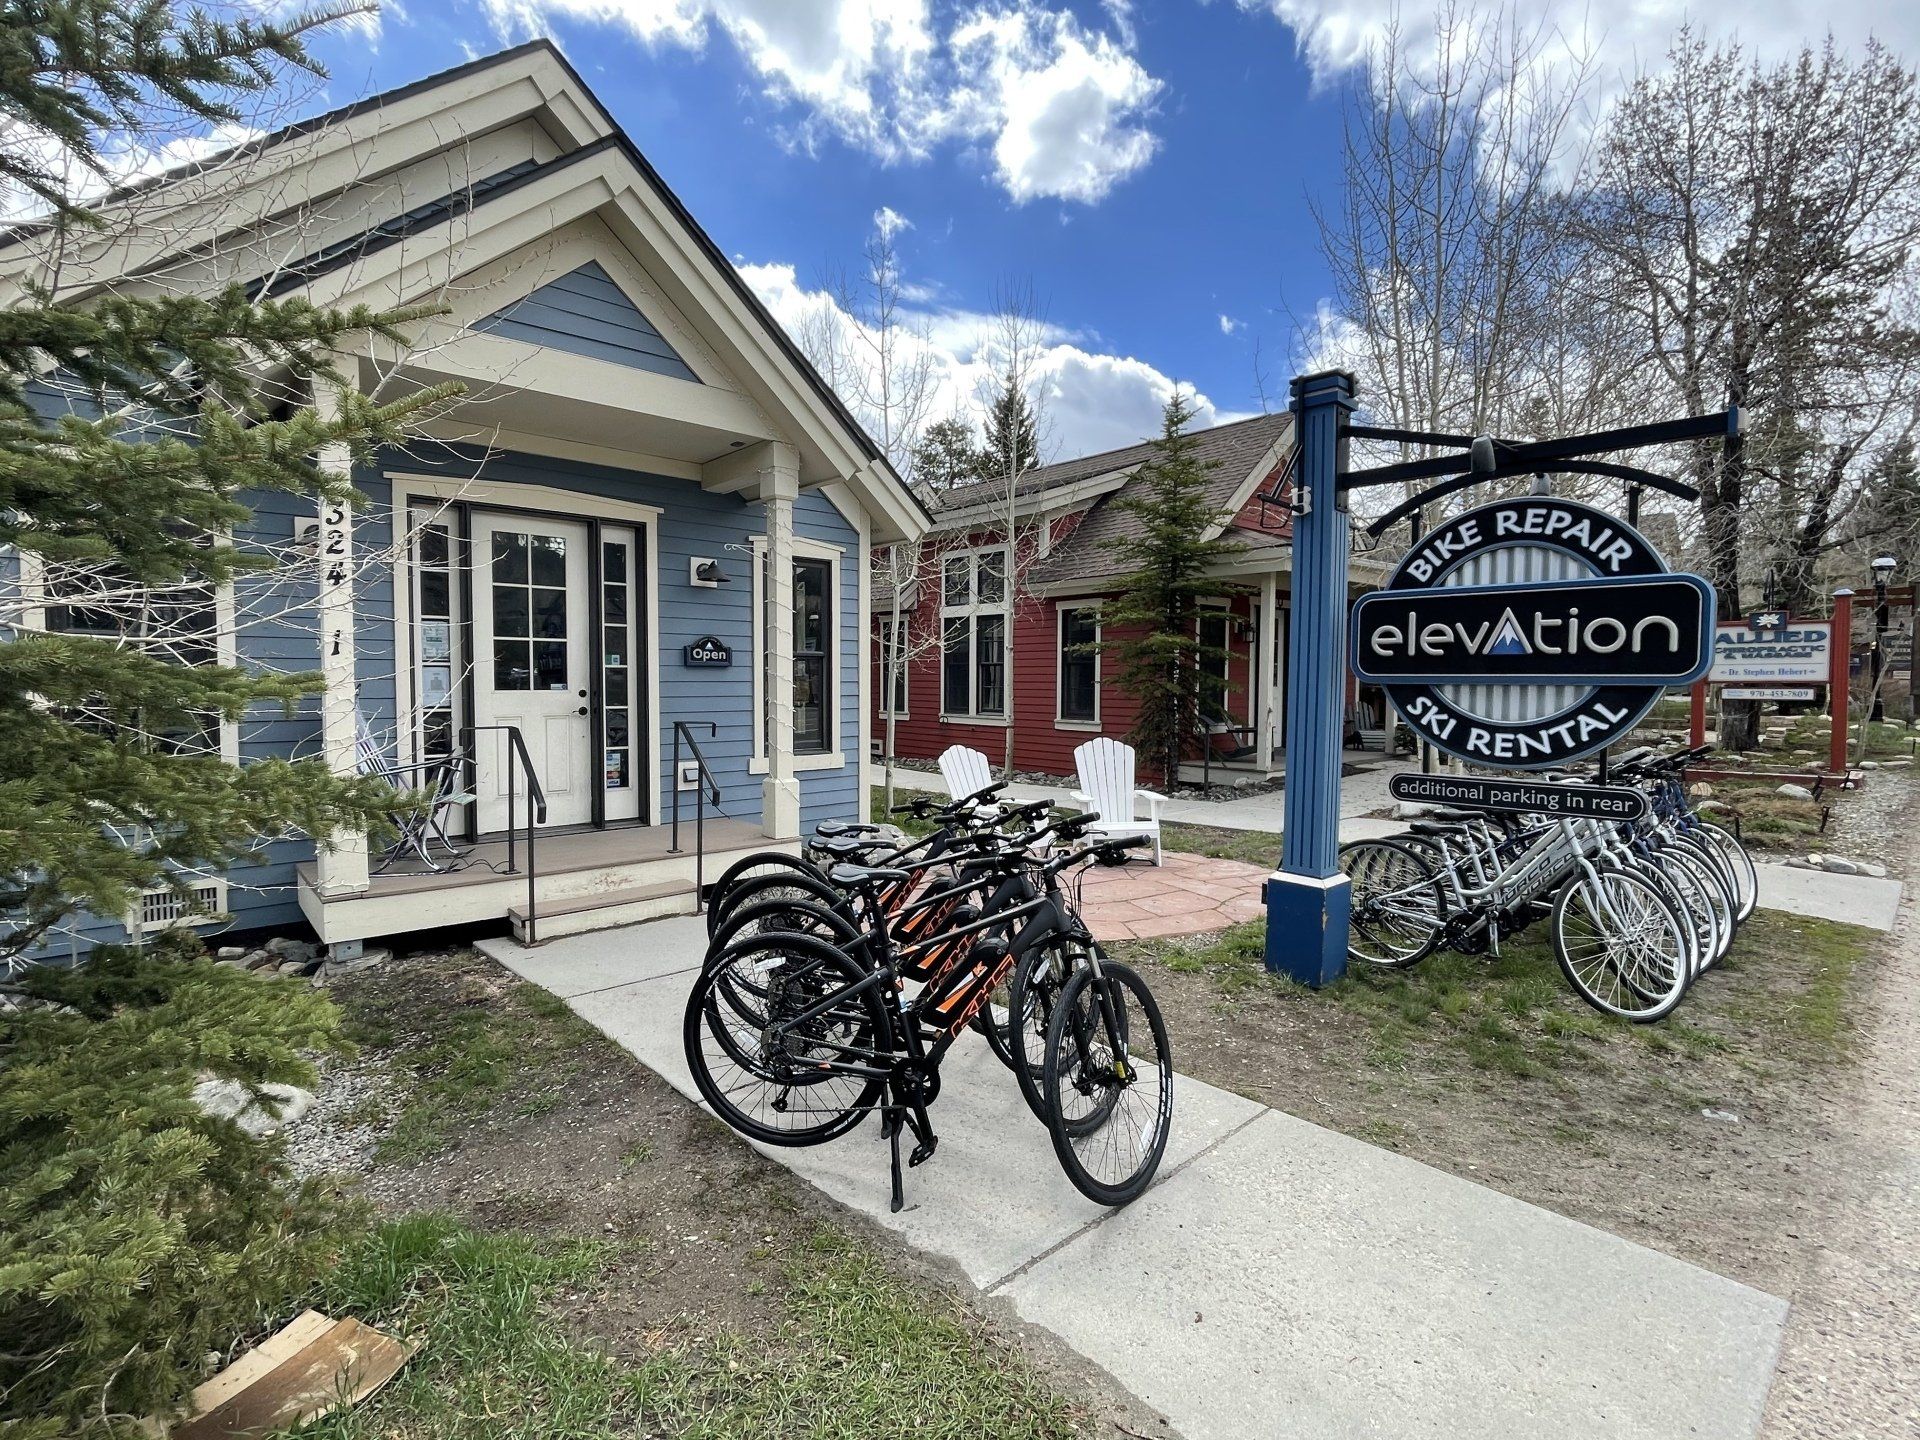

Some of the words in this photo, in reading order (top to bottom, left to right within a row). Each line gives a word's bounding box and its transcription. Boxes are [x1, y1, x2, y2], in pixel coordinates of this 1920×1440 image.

[1406, 519, 1483, 583] BIKE
[1495, 508, 1633, 572] REPAIR
[692, 648, 727, 662] Open
[1716, 630, 1828, 645] ALLIED
[1743, 668, 1775, 677] Stephen
[1406, 696, 1457, 741] SKI
[1466, 703, 1629, 758] RENTAL
[1399, 776, 1484, 800] additional
[1490, 785, 1560, 811] parking
[1566, 791, 1584, 808] in
[1591, 797, 1634, 813] rear
[1496, 857, 1551, 906] NORCO
